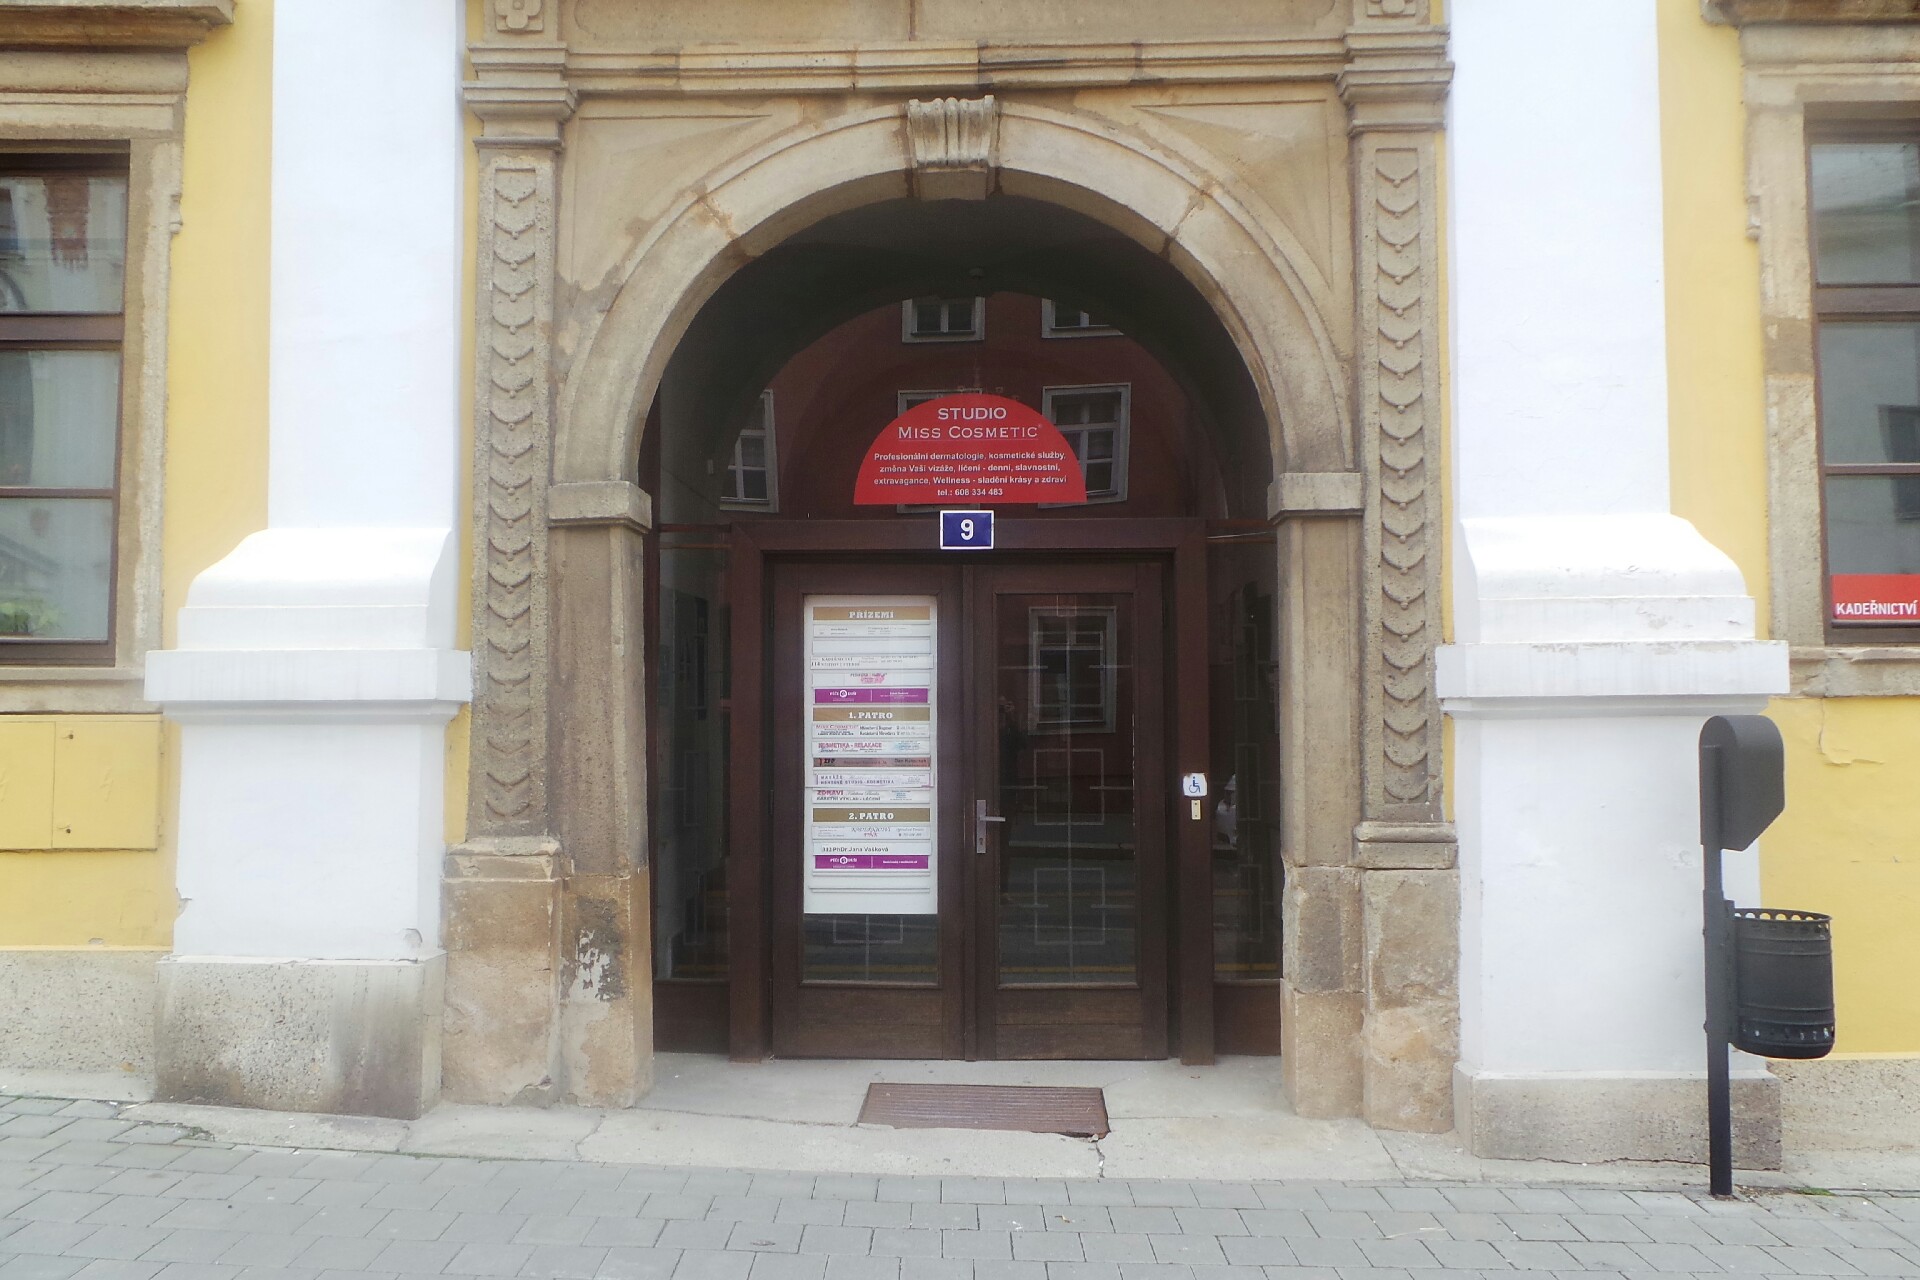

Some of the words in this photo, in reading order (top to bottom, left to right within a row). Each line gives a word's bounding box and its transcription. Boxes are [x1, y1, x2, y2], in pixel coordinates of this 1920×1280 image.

[938, 407, 1007, 420] STUDIO
[898, 426, 941, 439] MISS
[988, 452, 1036, 460] kosmetické
[880, 464, 907, 473] změna
[874, 476, 931, 486] extravagance,
[932, 476, 970, 484] Wellness
[1009, 476, 1032, 485] krásy
[988, 488, 1003, 496] 483
[960, 518, 974, 541] 9
[1836, 600, 1918, 615] KADEŘNICTVÍ
[848, 610, 894, 619] PŘÍZEMÍ
